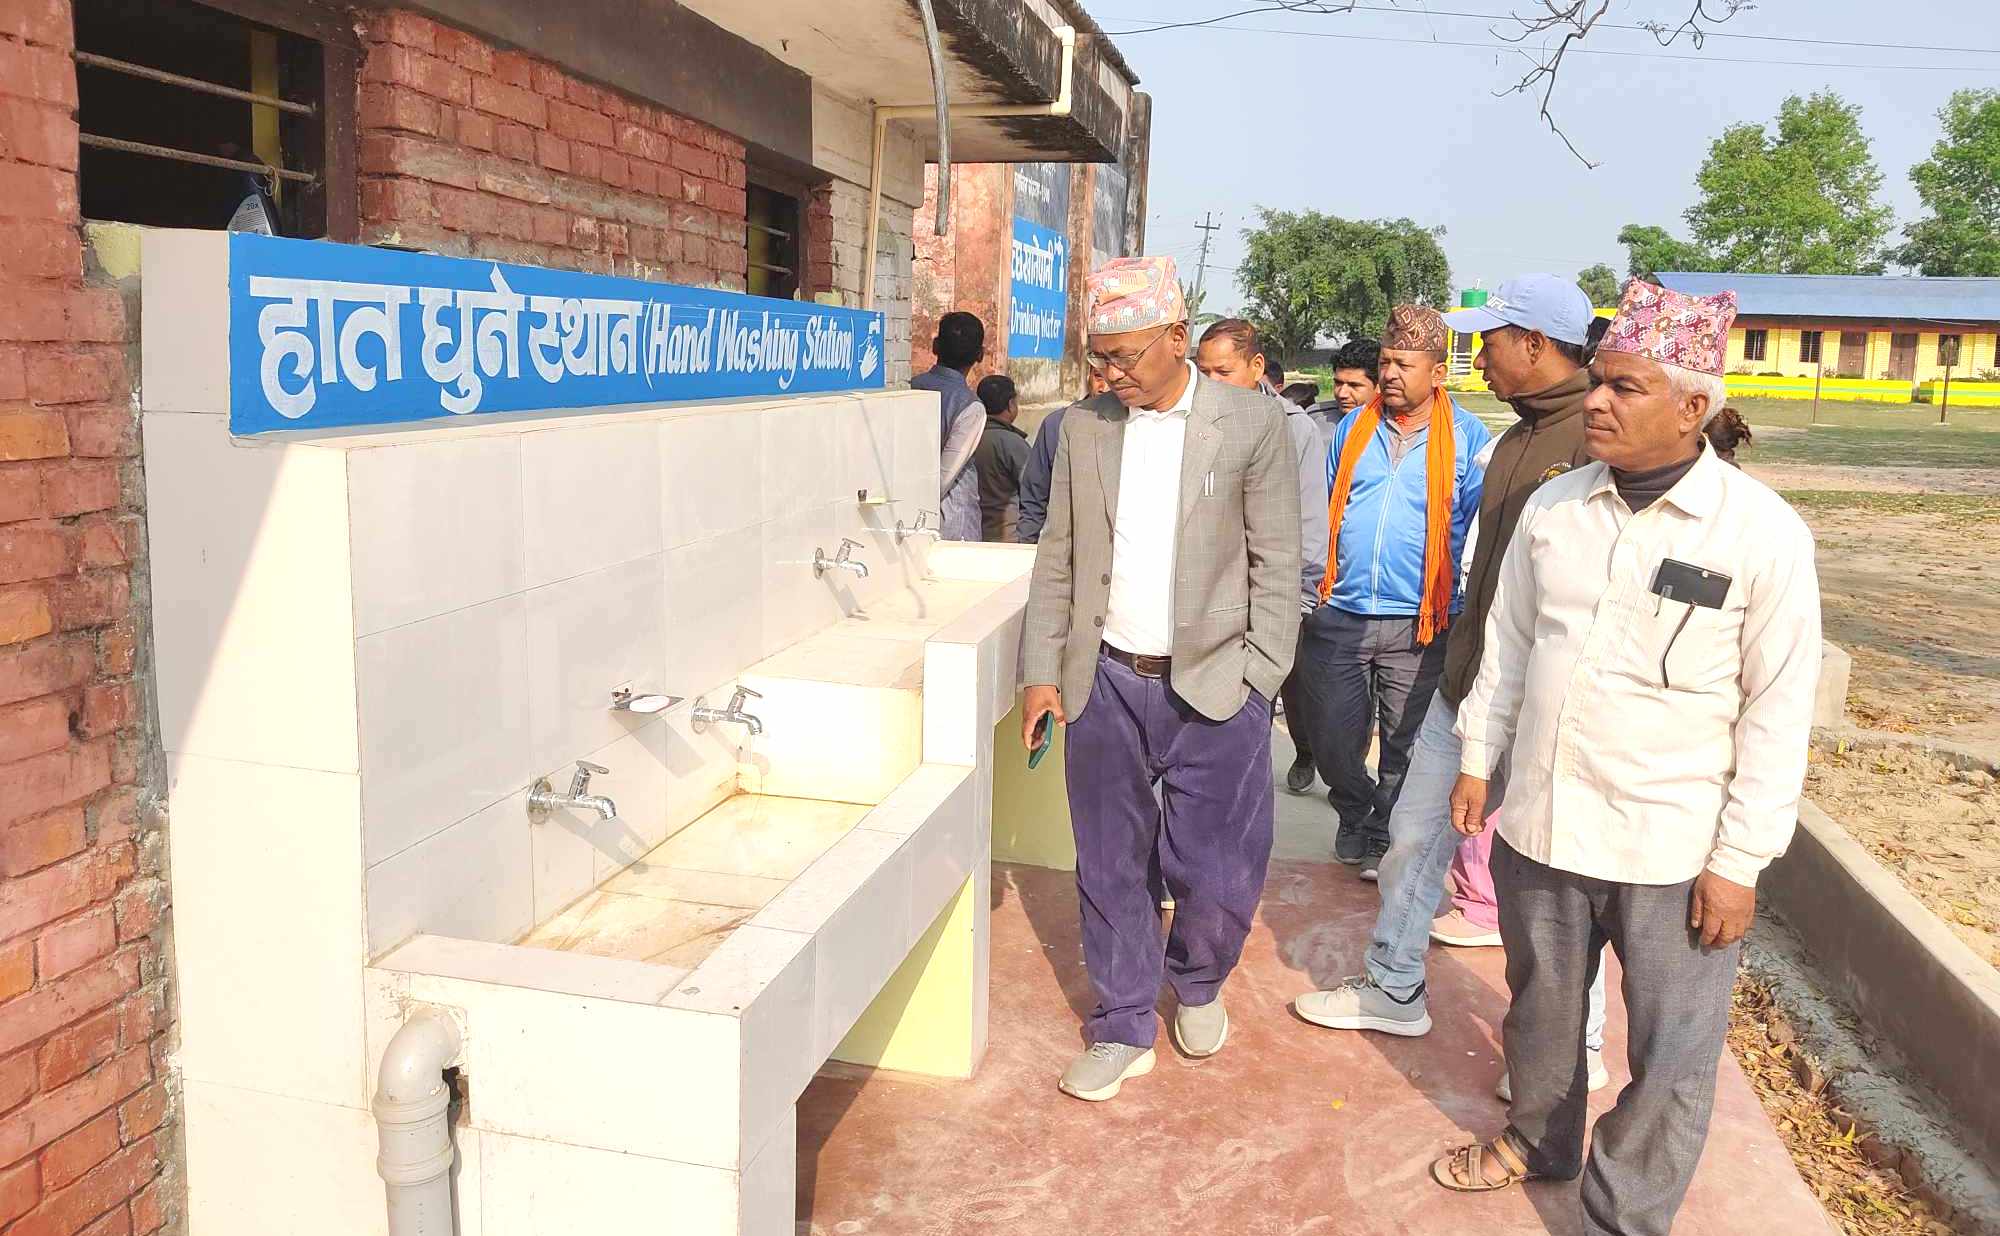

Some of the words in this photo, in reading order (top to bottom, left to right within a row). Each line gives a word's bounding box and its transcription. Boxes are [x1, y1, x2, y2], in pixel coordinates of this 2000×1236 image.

[249, 275, 411, 419] हात
[527, 295, 644, 384] स्थान
[642, 297, 715, 392] (Hand
[715, 308, 800, 391] Washing
[802, 314, 855, 382] Station)
[1010, 295, 1040, 354] Drinking
[1040, 308, 1062, 339] Water
